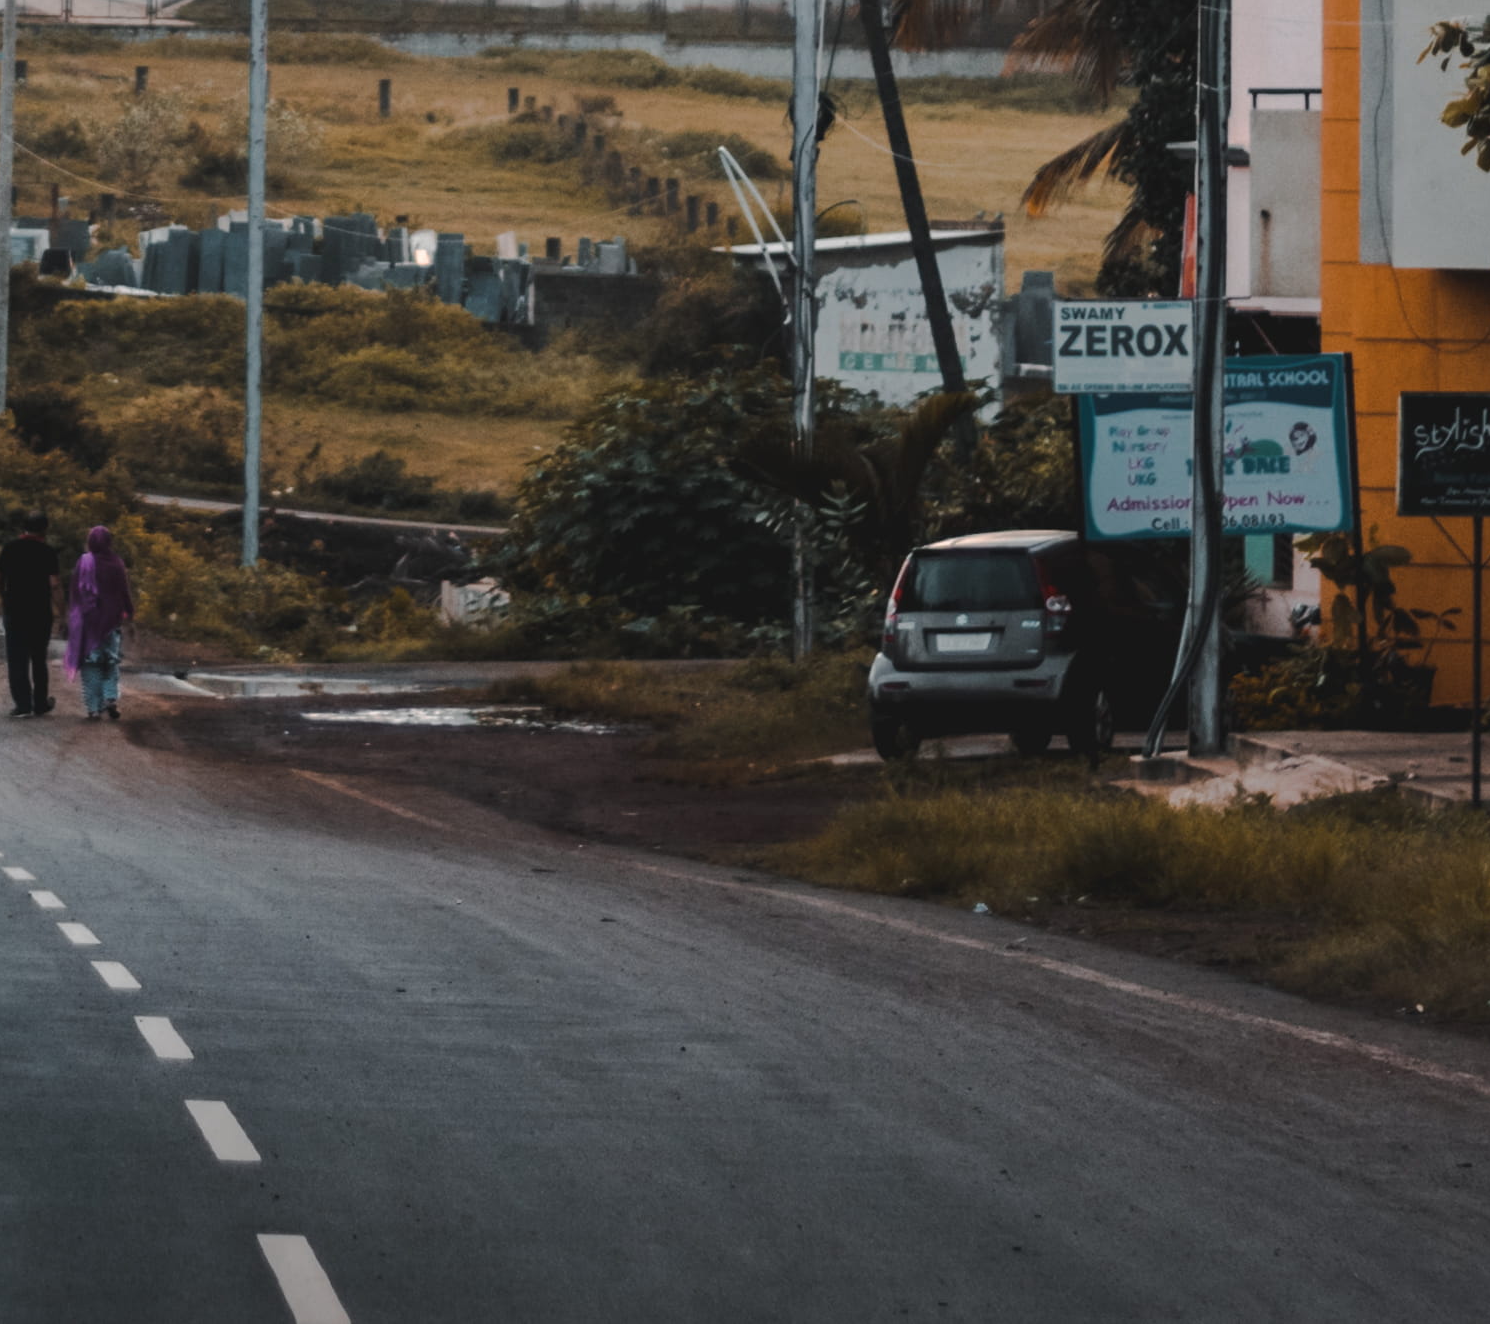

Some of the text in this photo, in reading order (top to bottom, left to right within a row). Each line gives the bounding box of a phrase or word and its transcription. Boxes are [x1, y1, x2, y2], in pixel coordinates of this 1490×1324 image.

[1061, 307, 1125, 319] SWAMY
[1059, 324, 1188, 357] ZEROX
[1268, 369, 1329, 385] SCHOOL
[1128, 456, 1155, 470] LKG
[1128, 472, 1156, 486] UKG
[1151, 516, 1180, 530] Cell
